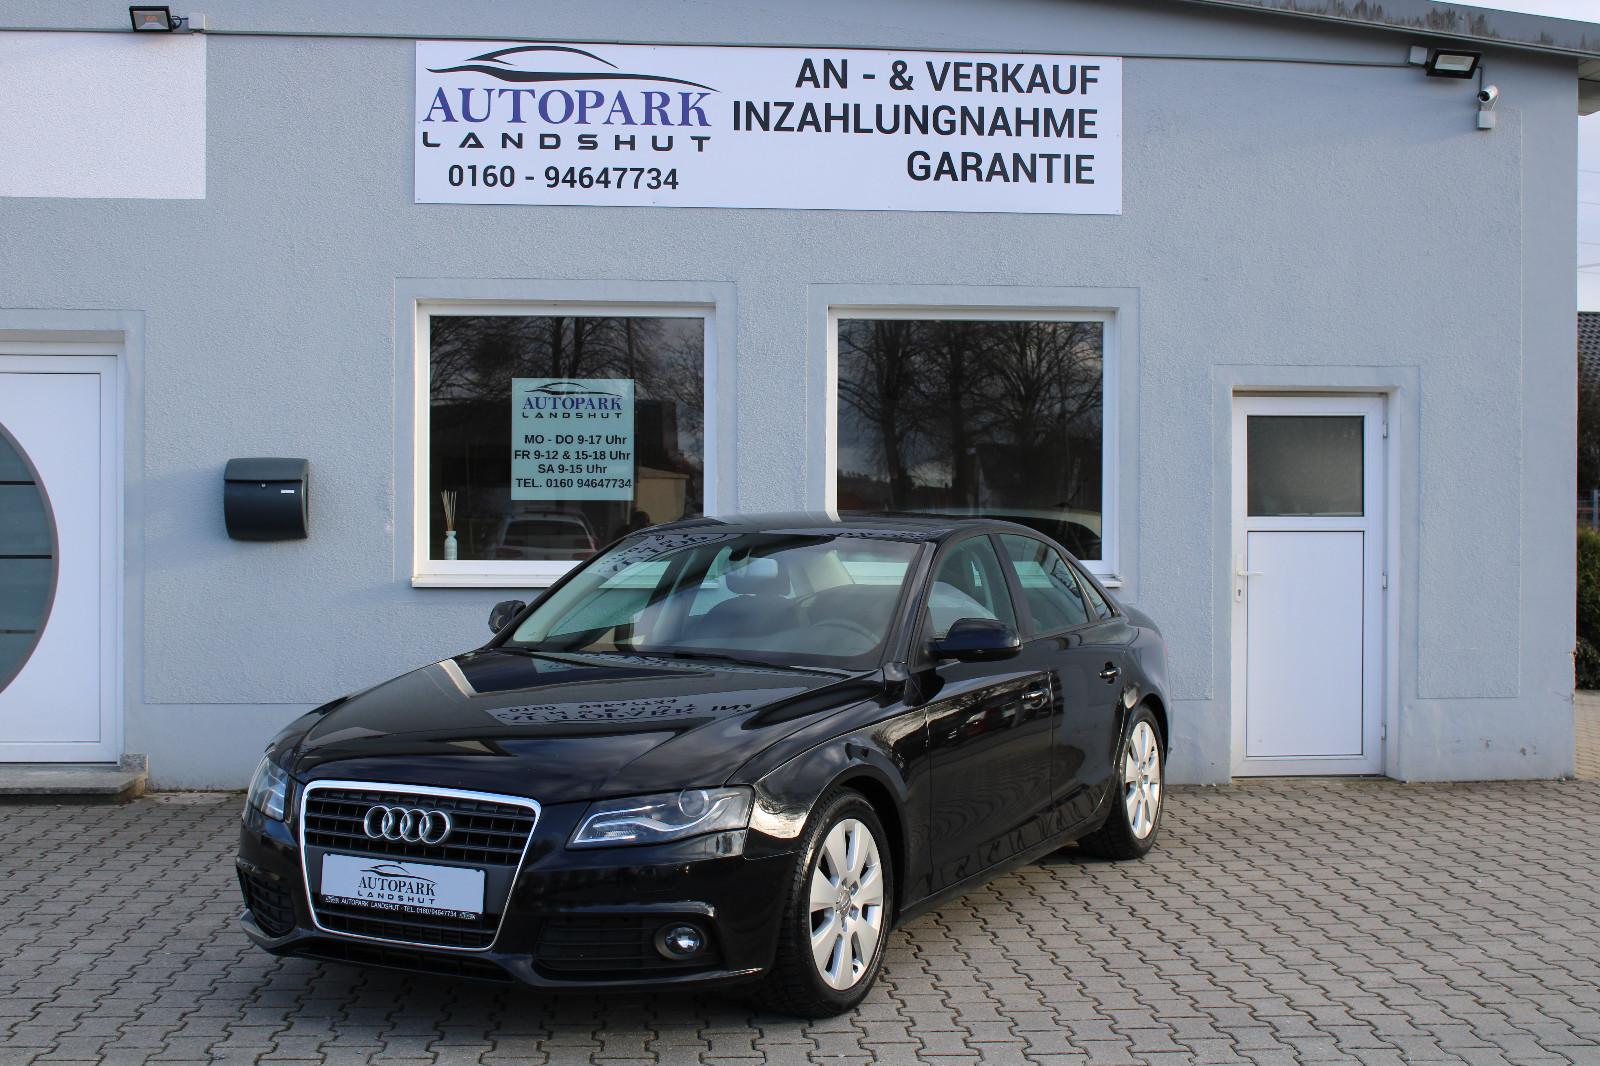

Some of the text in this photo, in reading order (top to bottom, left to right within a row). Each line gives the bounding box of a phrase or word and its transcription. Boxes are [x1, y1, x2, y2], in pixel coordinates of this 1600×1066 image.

[795, 58, 848, 88] AN
[889, 60, 914, 91] &
[926, 61, 1100, 95] VERKAUF
[423, 87, 713, 127] AUTOPARK
[733, 101, 1098, 139] INZAHLUNGNAHME
[422, 132, 712, 152] LANDSHUT
[907, 151, 1095, 184] GARANTIE
[449, 164, 515, 188] 0160
[544, 166, 679, 190] 94647734
[523, 396, 622, 410] AUTOPARK
[525, 435, 544, 444] MO
[556, 435, 573, 444] DO
[578, 435, 601, 445] 9-17
[606, 435, 627, 445] Uhr
[514, 450, 631, 460] FR 9-12 & 15-18 Uhr
[538, 464, 607, 474] SA 9-15 Uhr
[516, 478, 632, 488] TEL. 0160 94647734
[358, 876, 436, 896] AUTOPARK
[341, 898, 369, 906] AUTOPARK
[371, 901, 400, 910] LANDSHUT
[357, 890, 435, 904] LANDSHUT
